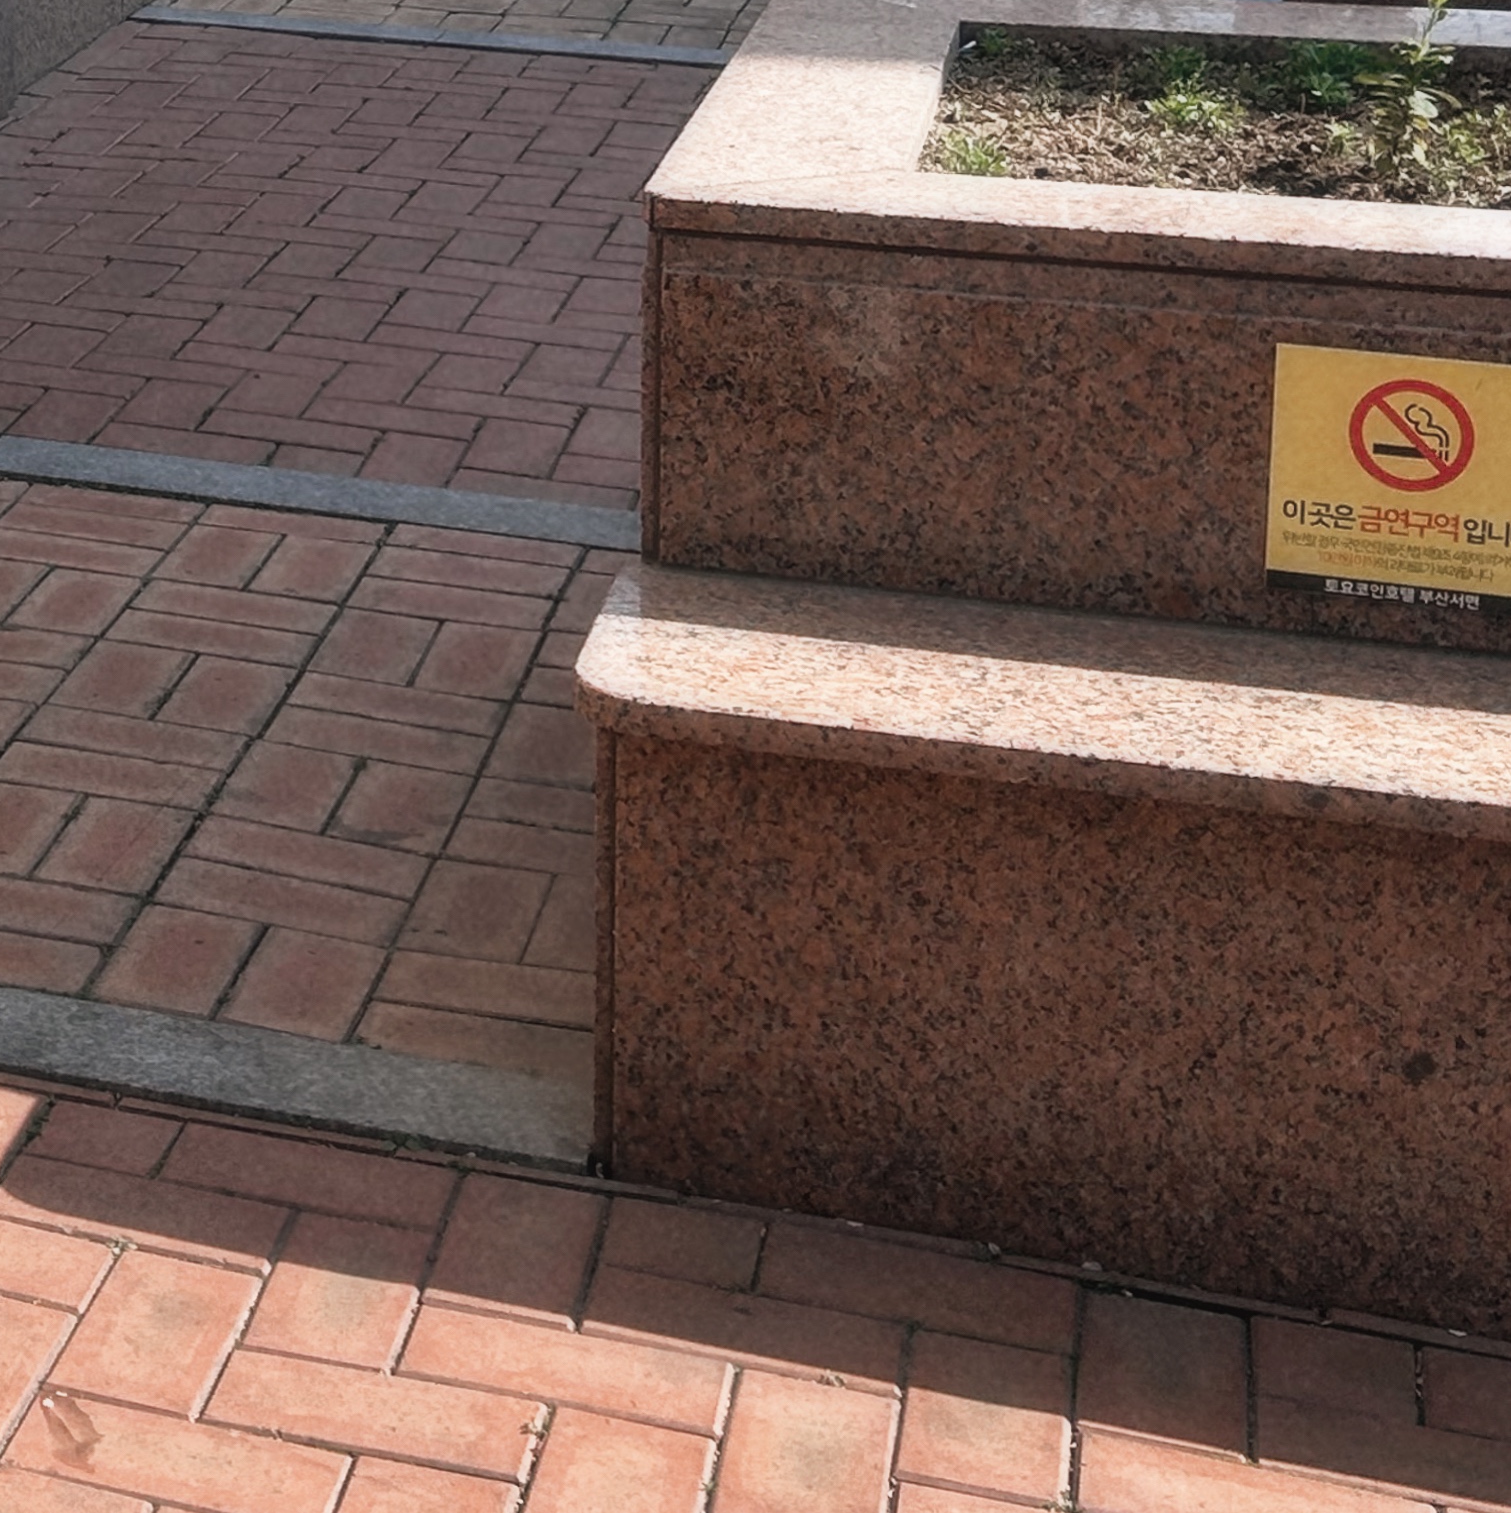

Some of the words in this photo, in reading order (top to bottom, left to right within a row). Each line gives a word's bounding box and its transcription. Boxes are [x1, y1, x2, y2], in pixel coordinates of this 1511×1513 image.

[1282, 500, 1356, 530] 이곳은
[1357, 504, 1460, 543] 금연구역
[1324, 578, 1416, 604] 토요코인호텔
[1418, 589, 1480, 611] 부산서면
